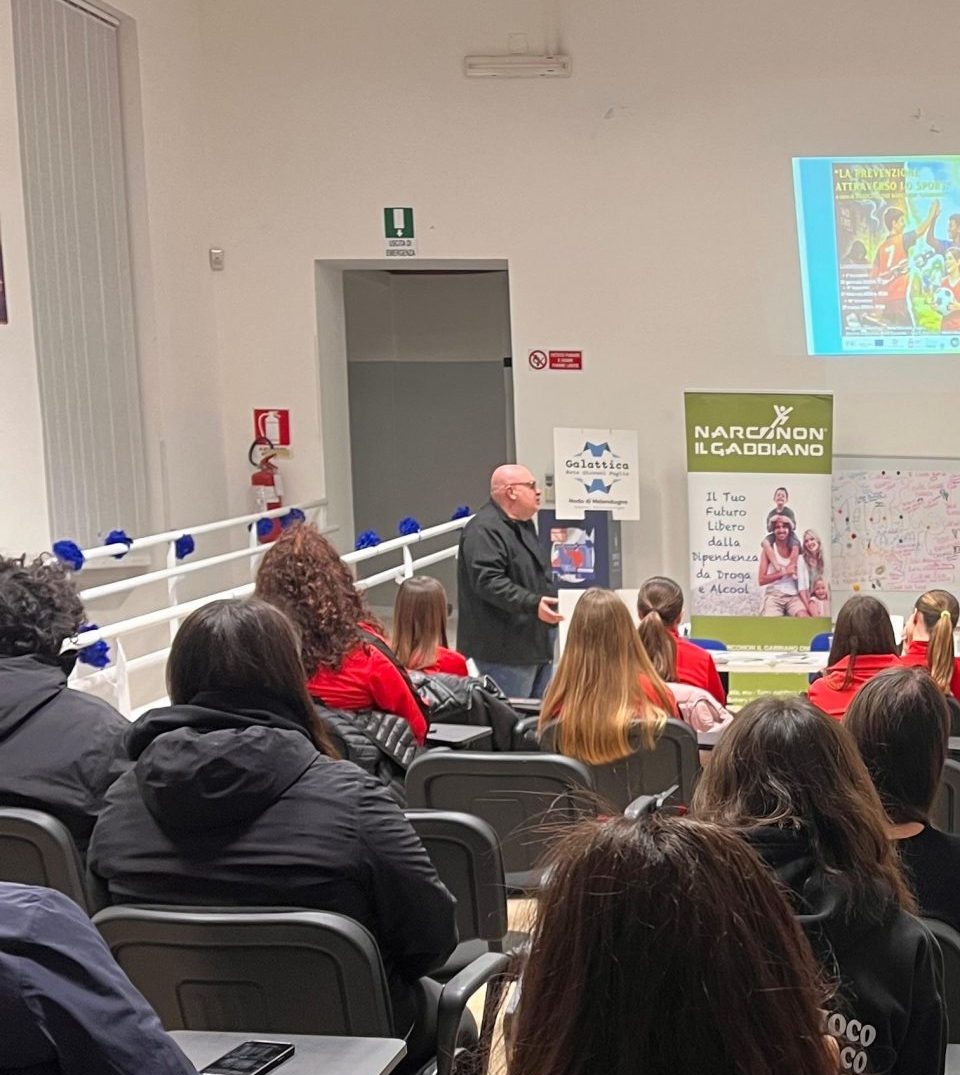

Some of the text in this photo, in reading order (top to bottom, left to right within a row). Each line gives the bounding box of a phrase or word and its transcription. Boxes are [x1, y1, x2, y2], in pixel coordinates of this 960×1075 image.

[694, 425, 824, 441] NARCONON
[565, 459, 630, 470] Galattica
[706, 491, 746, 502] Il Tuo
[705, 506, 747, 517] Futuro
[707, 519, 746, 531] Libero
[707, 535, 741, 547] dalla
[691, 550, 759, 567] Dipendenza
[696, 567, 752, 583] da Droga
[698, 583, 750, 594] e Alcool
